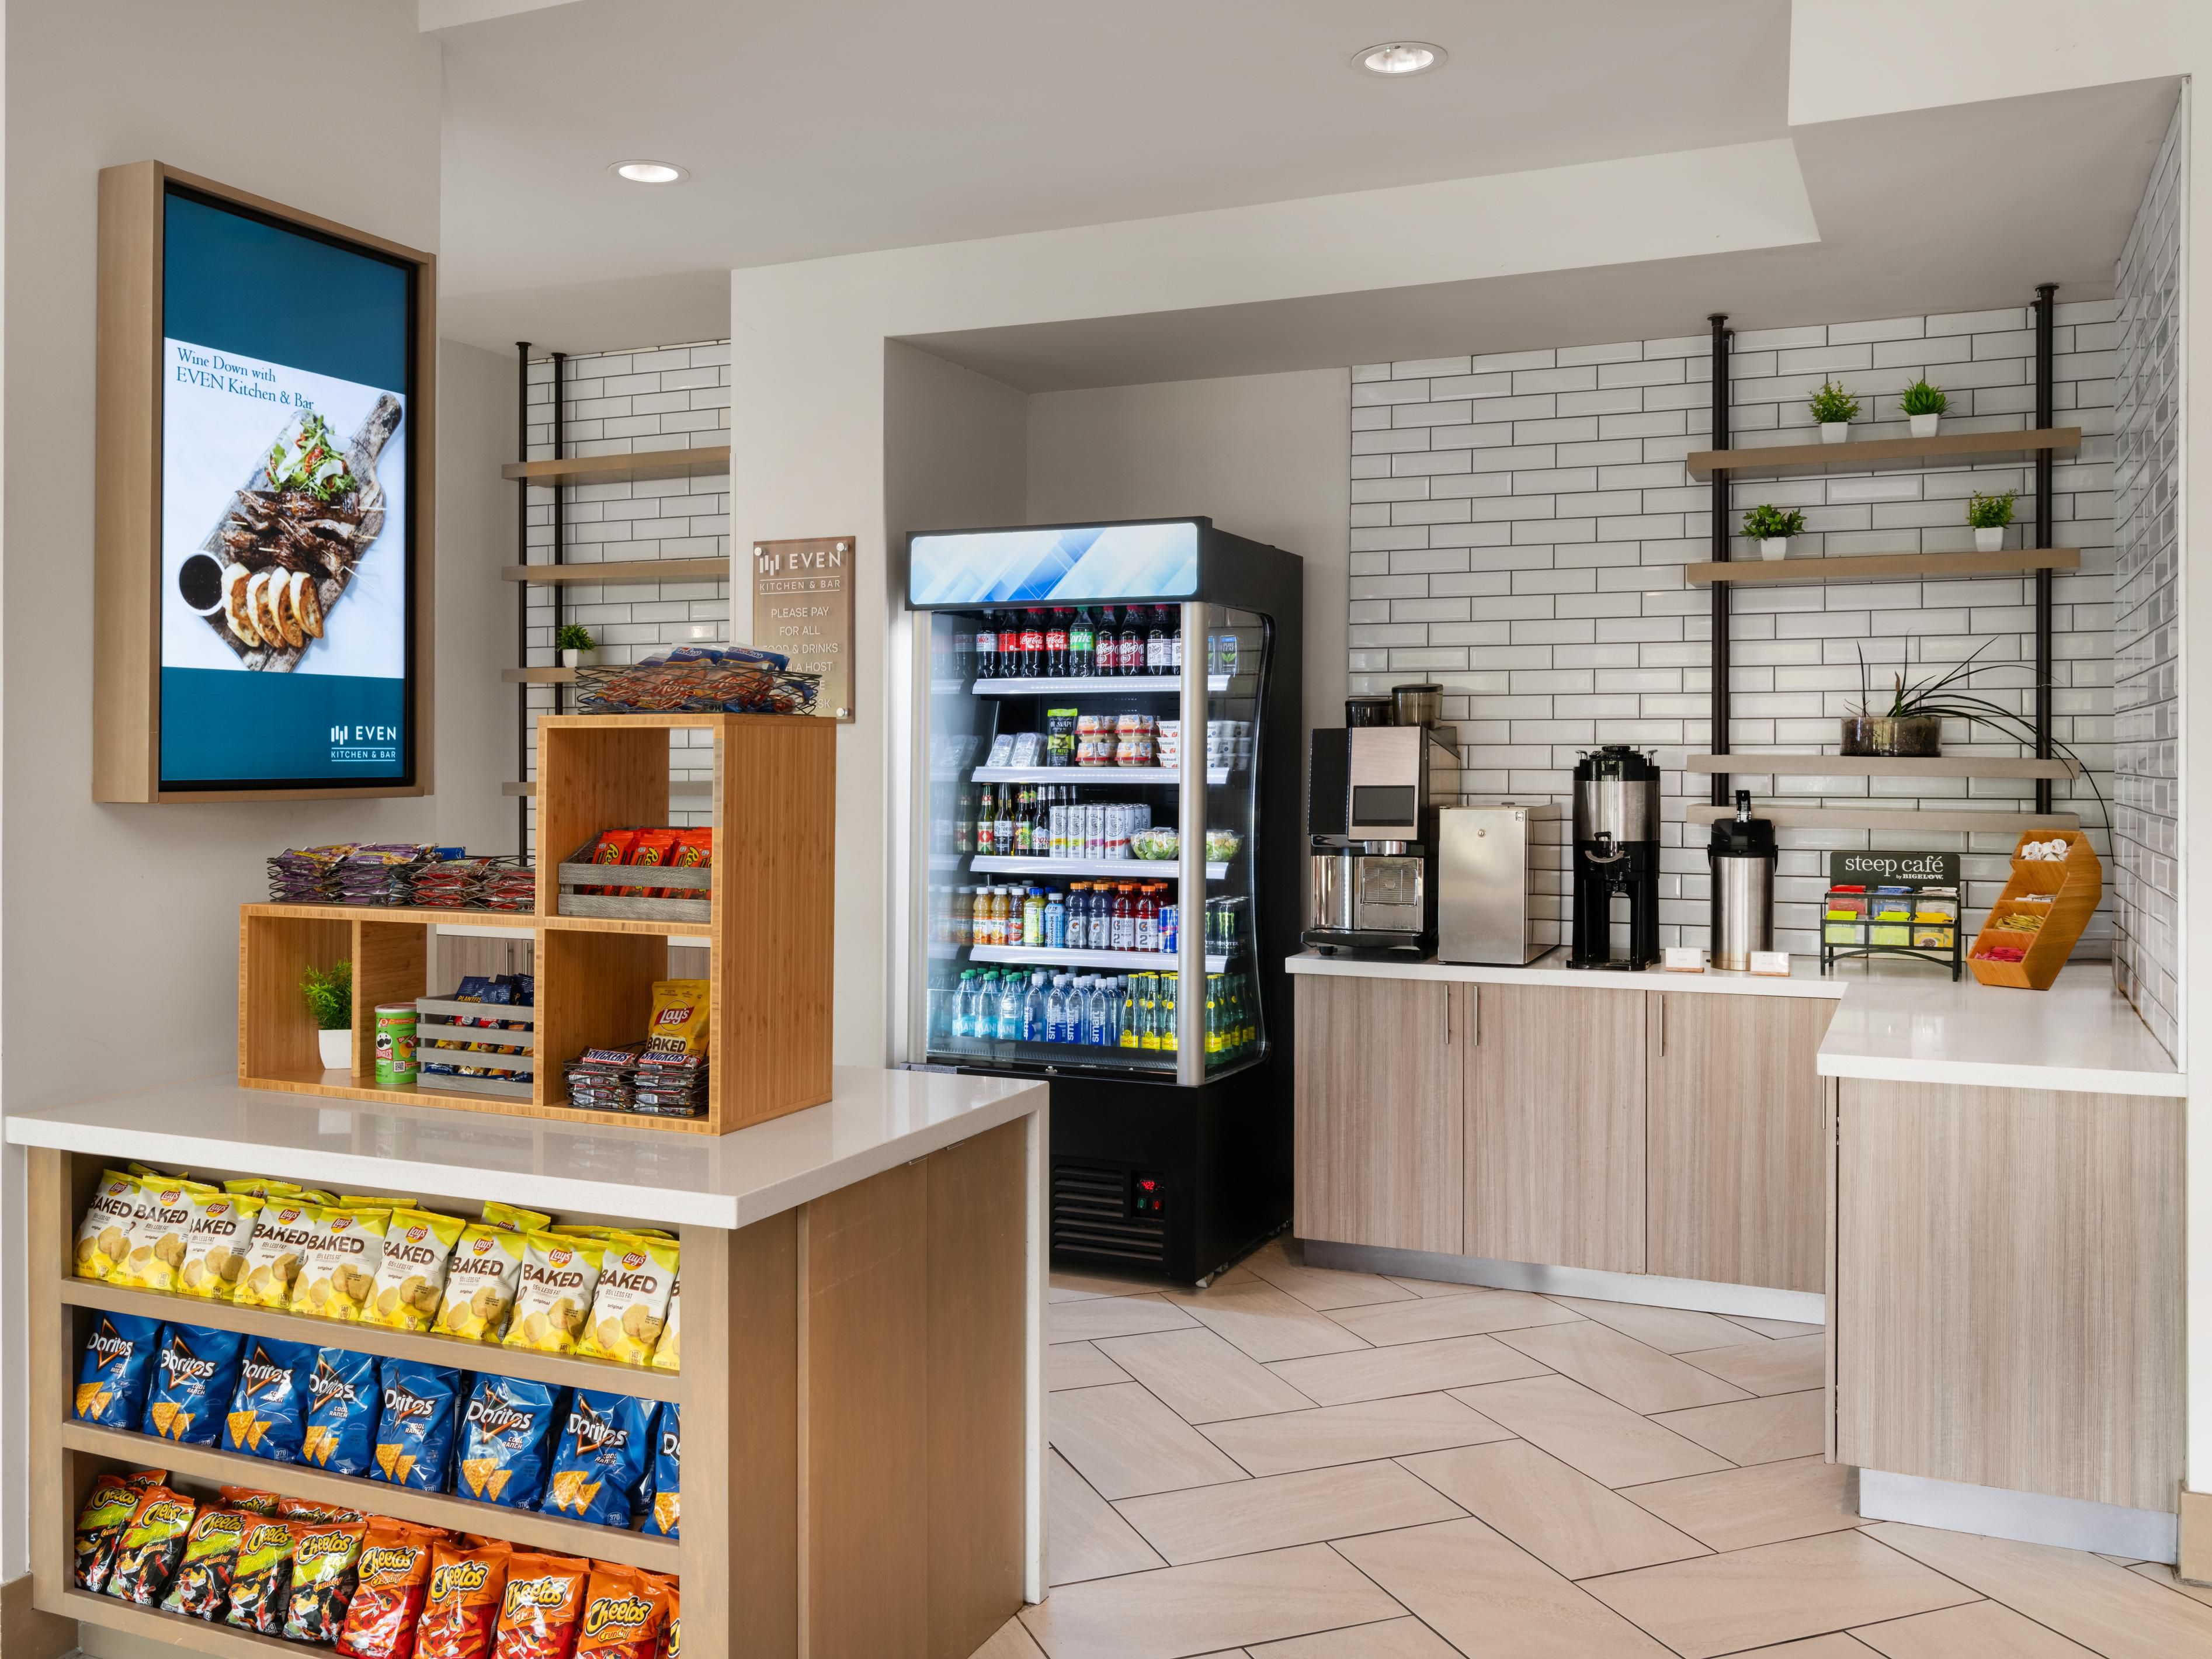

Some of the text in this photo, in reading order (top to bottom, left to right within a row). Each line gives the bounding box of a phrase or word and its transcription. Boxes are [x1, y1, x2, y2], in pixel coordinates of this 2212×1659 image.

[177, 347, 276, 382] Wine Down with
[176, 366, 314, 410] EVEN Kitchen & Bar
[790, 551, 841, 569] EVEN
[760, 582, 804, 591] KITCHEN
[821, 580, 840, 588] BAR
[772, 607, 829, 618] PLEASE PAY
[780, 626, 820, 636] FOR ALL
[793, 645, 799, 654] &
[803, 643, 838, 653] DRINKS
[796, 663, 802, 672] A
[806, 662, 833, 672] HOST
[356, 726, 395, 740] EVEN
[1845, 855, 1943, 877] steep café
[659, 1008, 690, 1025] Lay's
[647, 1036, 686, 1053] BAKED
[587, 1049, 631, 1062] SNICKERS
[643, 1051, 685, 1062] SNICKERS
[111, 1182, 127, 1193] Lay's
[161, 1191, 180, 1201] Lay's
[134, 1204, 187, 1223] BAKED
[208, 1203, 228, 1213] Lay's
[280, 1209, 299, 1220] Lay's
[332, 1218, 352, 1228] Lay's
[253, 1223, 309, 1245] BAKED
[408, 1227, 428, 1239] Lay's
[307, 1235, 364, 1254] BAKED
[474, 1238, 494, 1251] Lay's
[550, 1249, 570, 1264] Lay's
[626, 1252, 645, 1266] Lay's
[452, 1257, 503, 1276] BAKED
[524, 1264, 583, 1287] BAKED
[599, 1269, 657, 1294] BAKED
[87, 1332, 133, 1356] Doritos
[161, 1349, 216, 1377] Doritos
[242, 1360, 294, 1387] Doritos
[310, 1374, 355, 1398] Doritos
[468, 1401, 534, 1429] Doritos
[570, 1413, 628, 1445] Doritos
[92, 1488, 137, 1509] Cheetos
[198, 1512, 244, 1540] Cheetos
[297, 1530, 352, 1564] Cheetos
[203, 1555, 230, 1566] Crunchy
[358, 1547, 416, 1581] Cheetos
[314, 1578, 343, 1591] Crunchy
[371, 1574, 401, 1587] Crunchy
[431, 1560, 487, 1602] Cheetos
[506, 1576, 567, 1618] Cheetos
[585, 1597, 652, 1635] Cheetos
[598, 1627, 630, 1641] Crunchy
